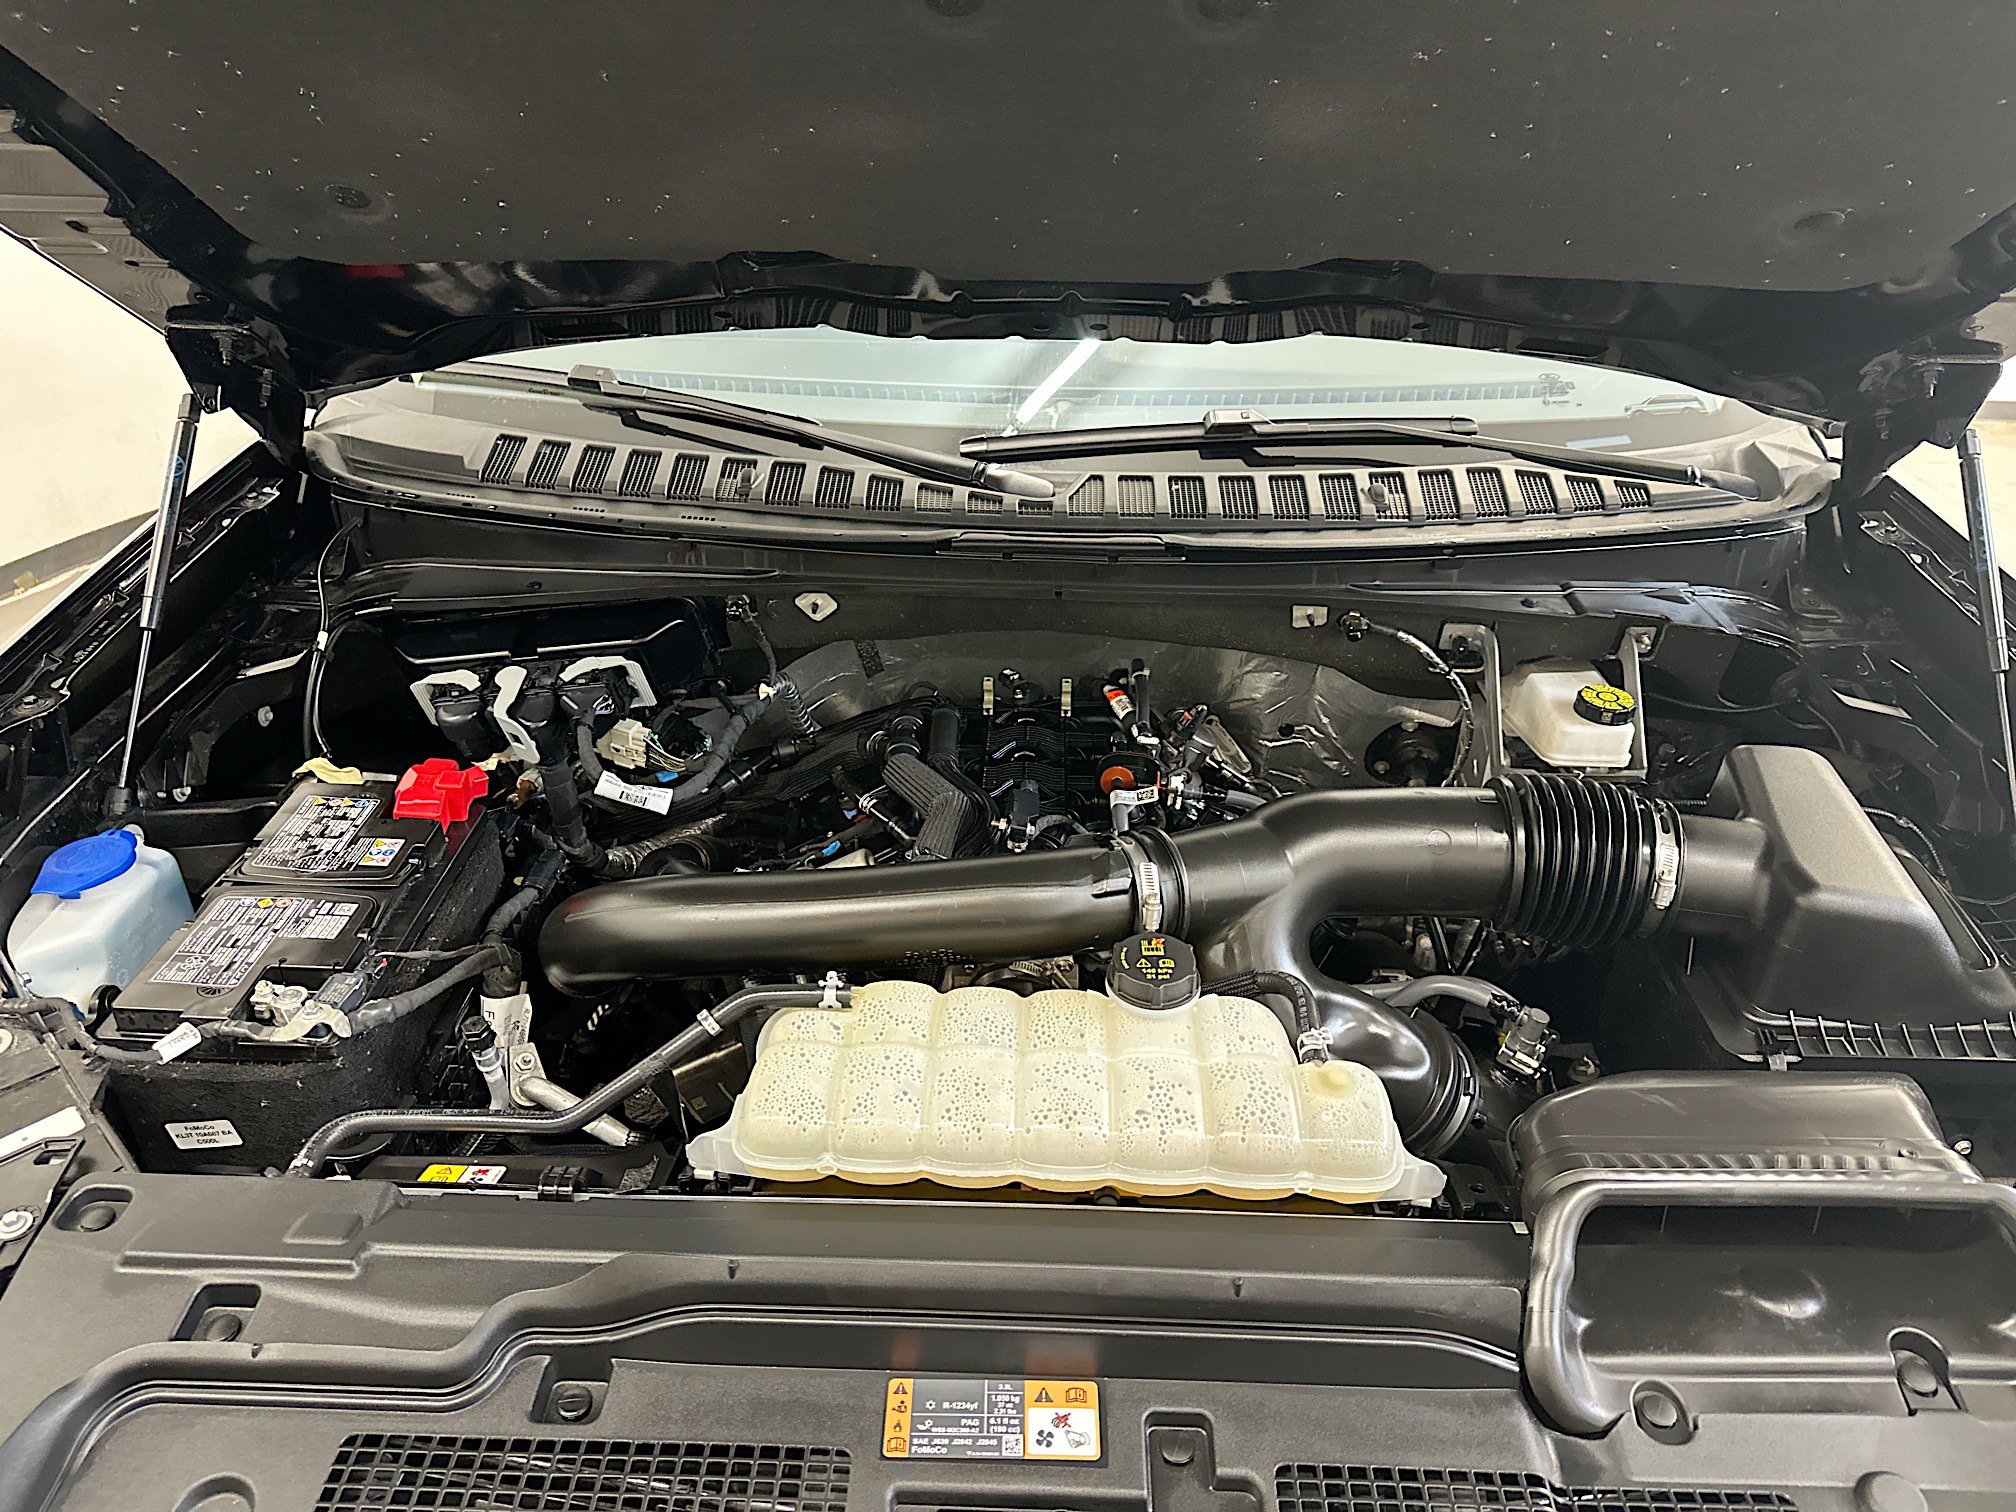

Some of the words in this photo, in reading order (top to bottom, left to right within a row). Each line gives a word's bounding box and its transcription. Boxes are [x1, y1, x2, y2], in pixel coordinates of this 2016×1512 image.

[1011, 1395, 1020, 1403] kg
[942, 1401, 979, 1411] R-1234yf
[960, 1418, 980, 1426] PAG
[911, 1446, 948, 1454] FoMoCo
